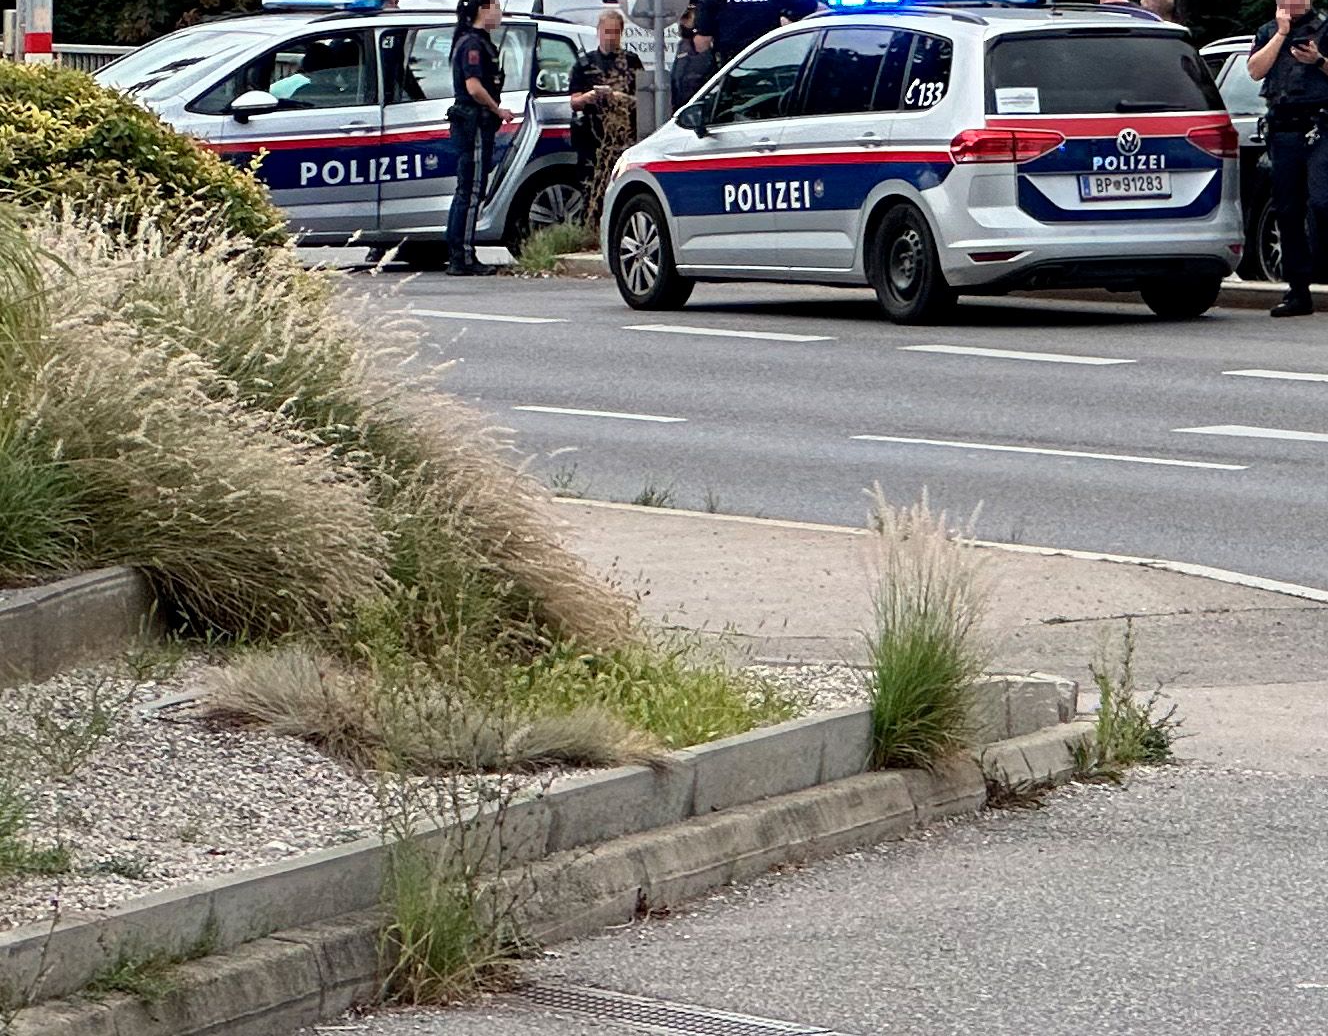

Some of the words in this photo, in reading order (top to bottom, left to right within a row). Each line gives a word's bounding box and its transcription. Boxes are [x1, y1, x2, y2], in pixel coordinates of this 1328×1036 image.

[551, 72, 570, 92] 13
[918, 81, 944, 107] 133
[300, 154, 422, 186] POLIZEI
[1092, 154, 1166, 171] POLIZEI
[1122, 175, 1163, 192] 91283
[724, 180, 811, 212] POLIZEI
